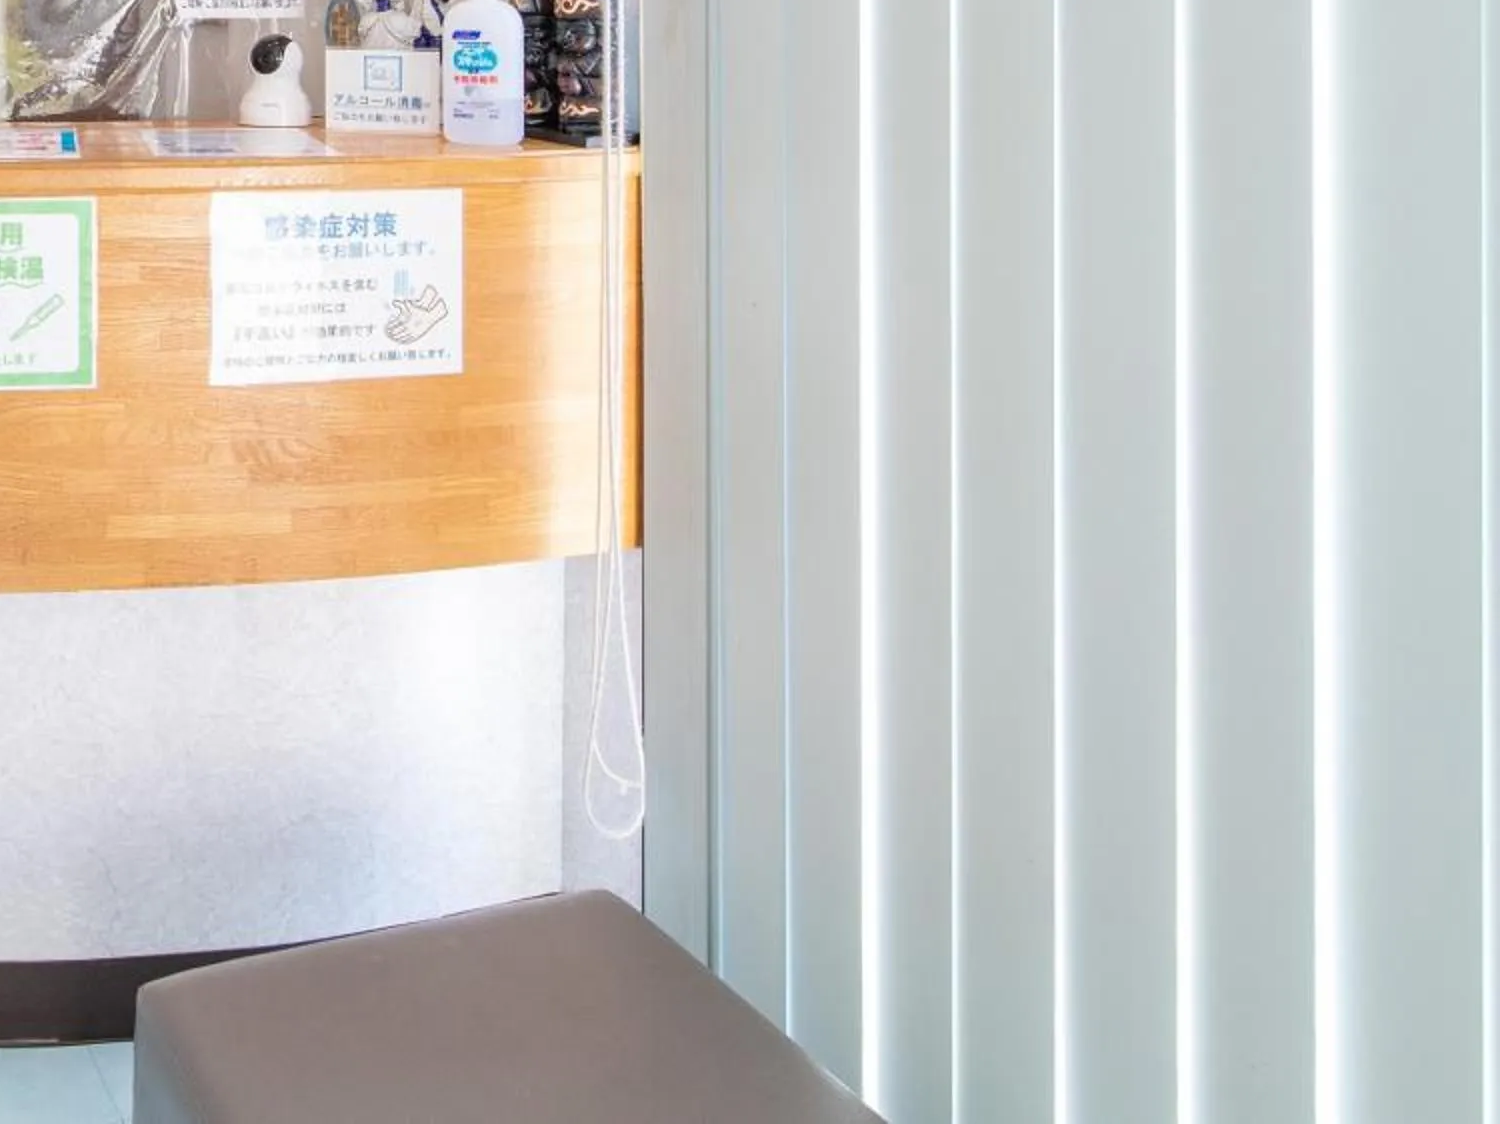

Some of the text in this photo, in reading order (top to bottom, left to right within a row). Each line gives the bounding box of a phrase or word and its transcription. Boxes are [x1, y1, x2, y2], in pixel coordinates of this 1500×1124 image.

[265, 211, 398, 241] 感染症対策
